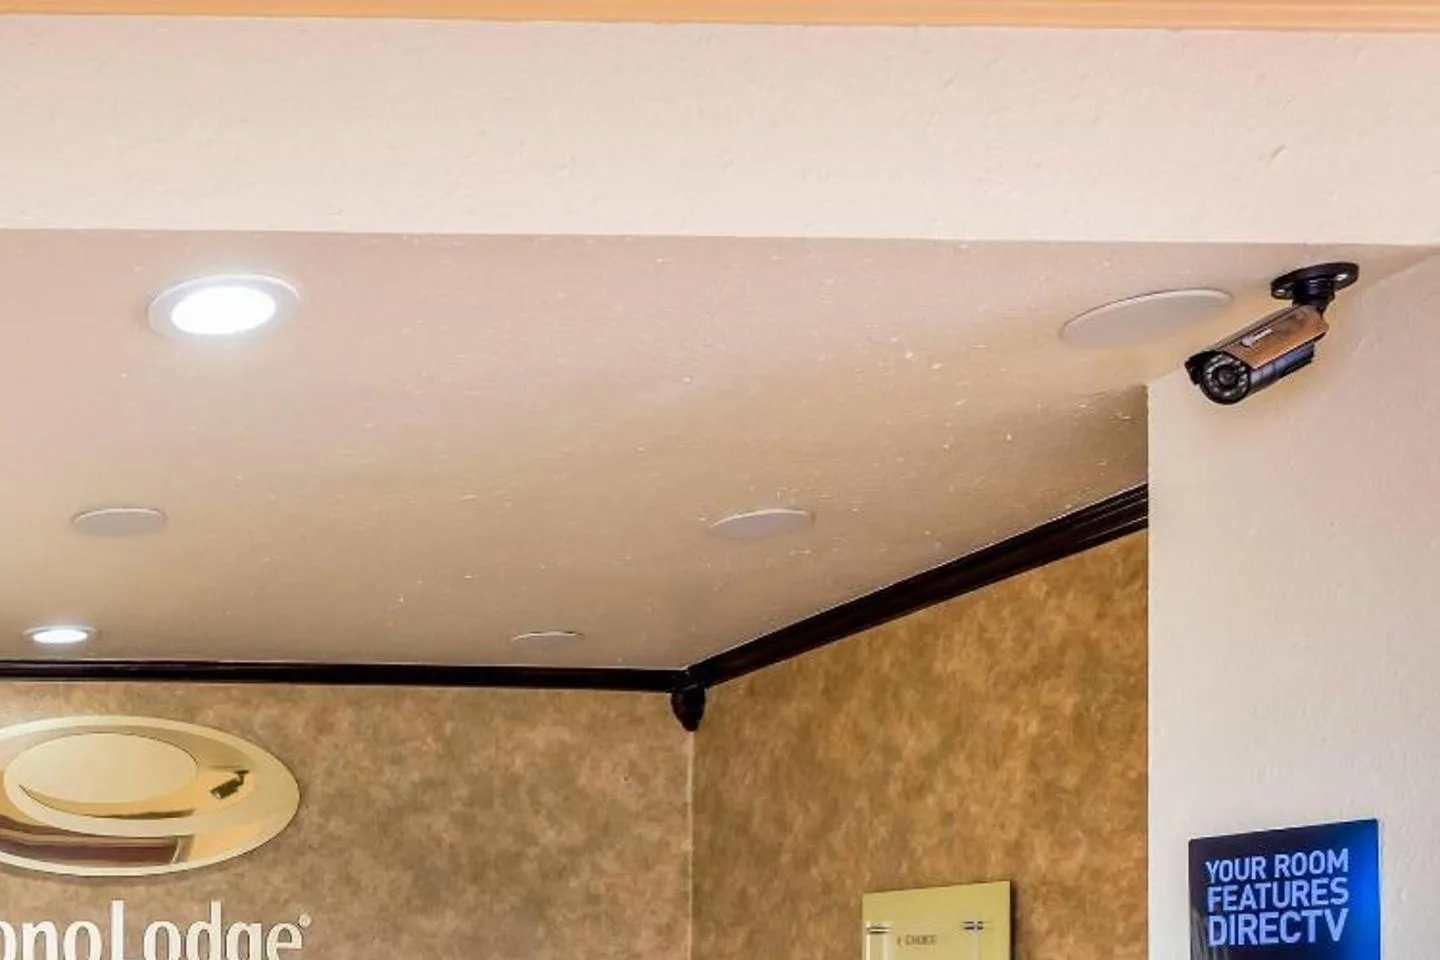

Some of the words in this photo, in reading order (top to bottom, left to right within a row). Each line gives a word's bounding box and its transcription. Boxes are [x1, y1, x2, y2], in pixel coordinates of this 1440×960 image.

[1205, 855, 1266, 884] YOUR
[1274, 848, 1349, 878] ROOM
[1207, 877, 1349, 913] FEATURES
[1208, 908, 1349, 947] DIRECTV
